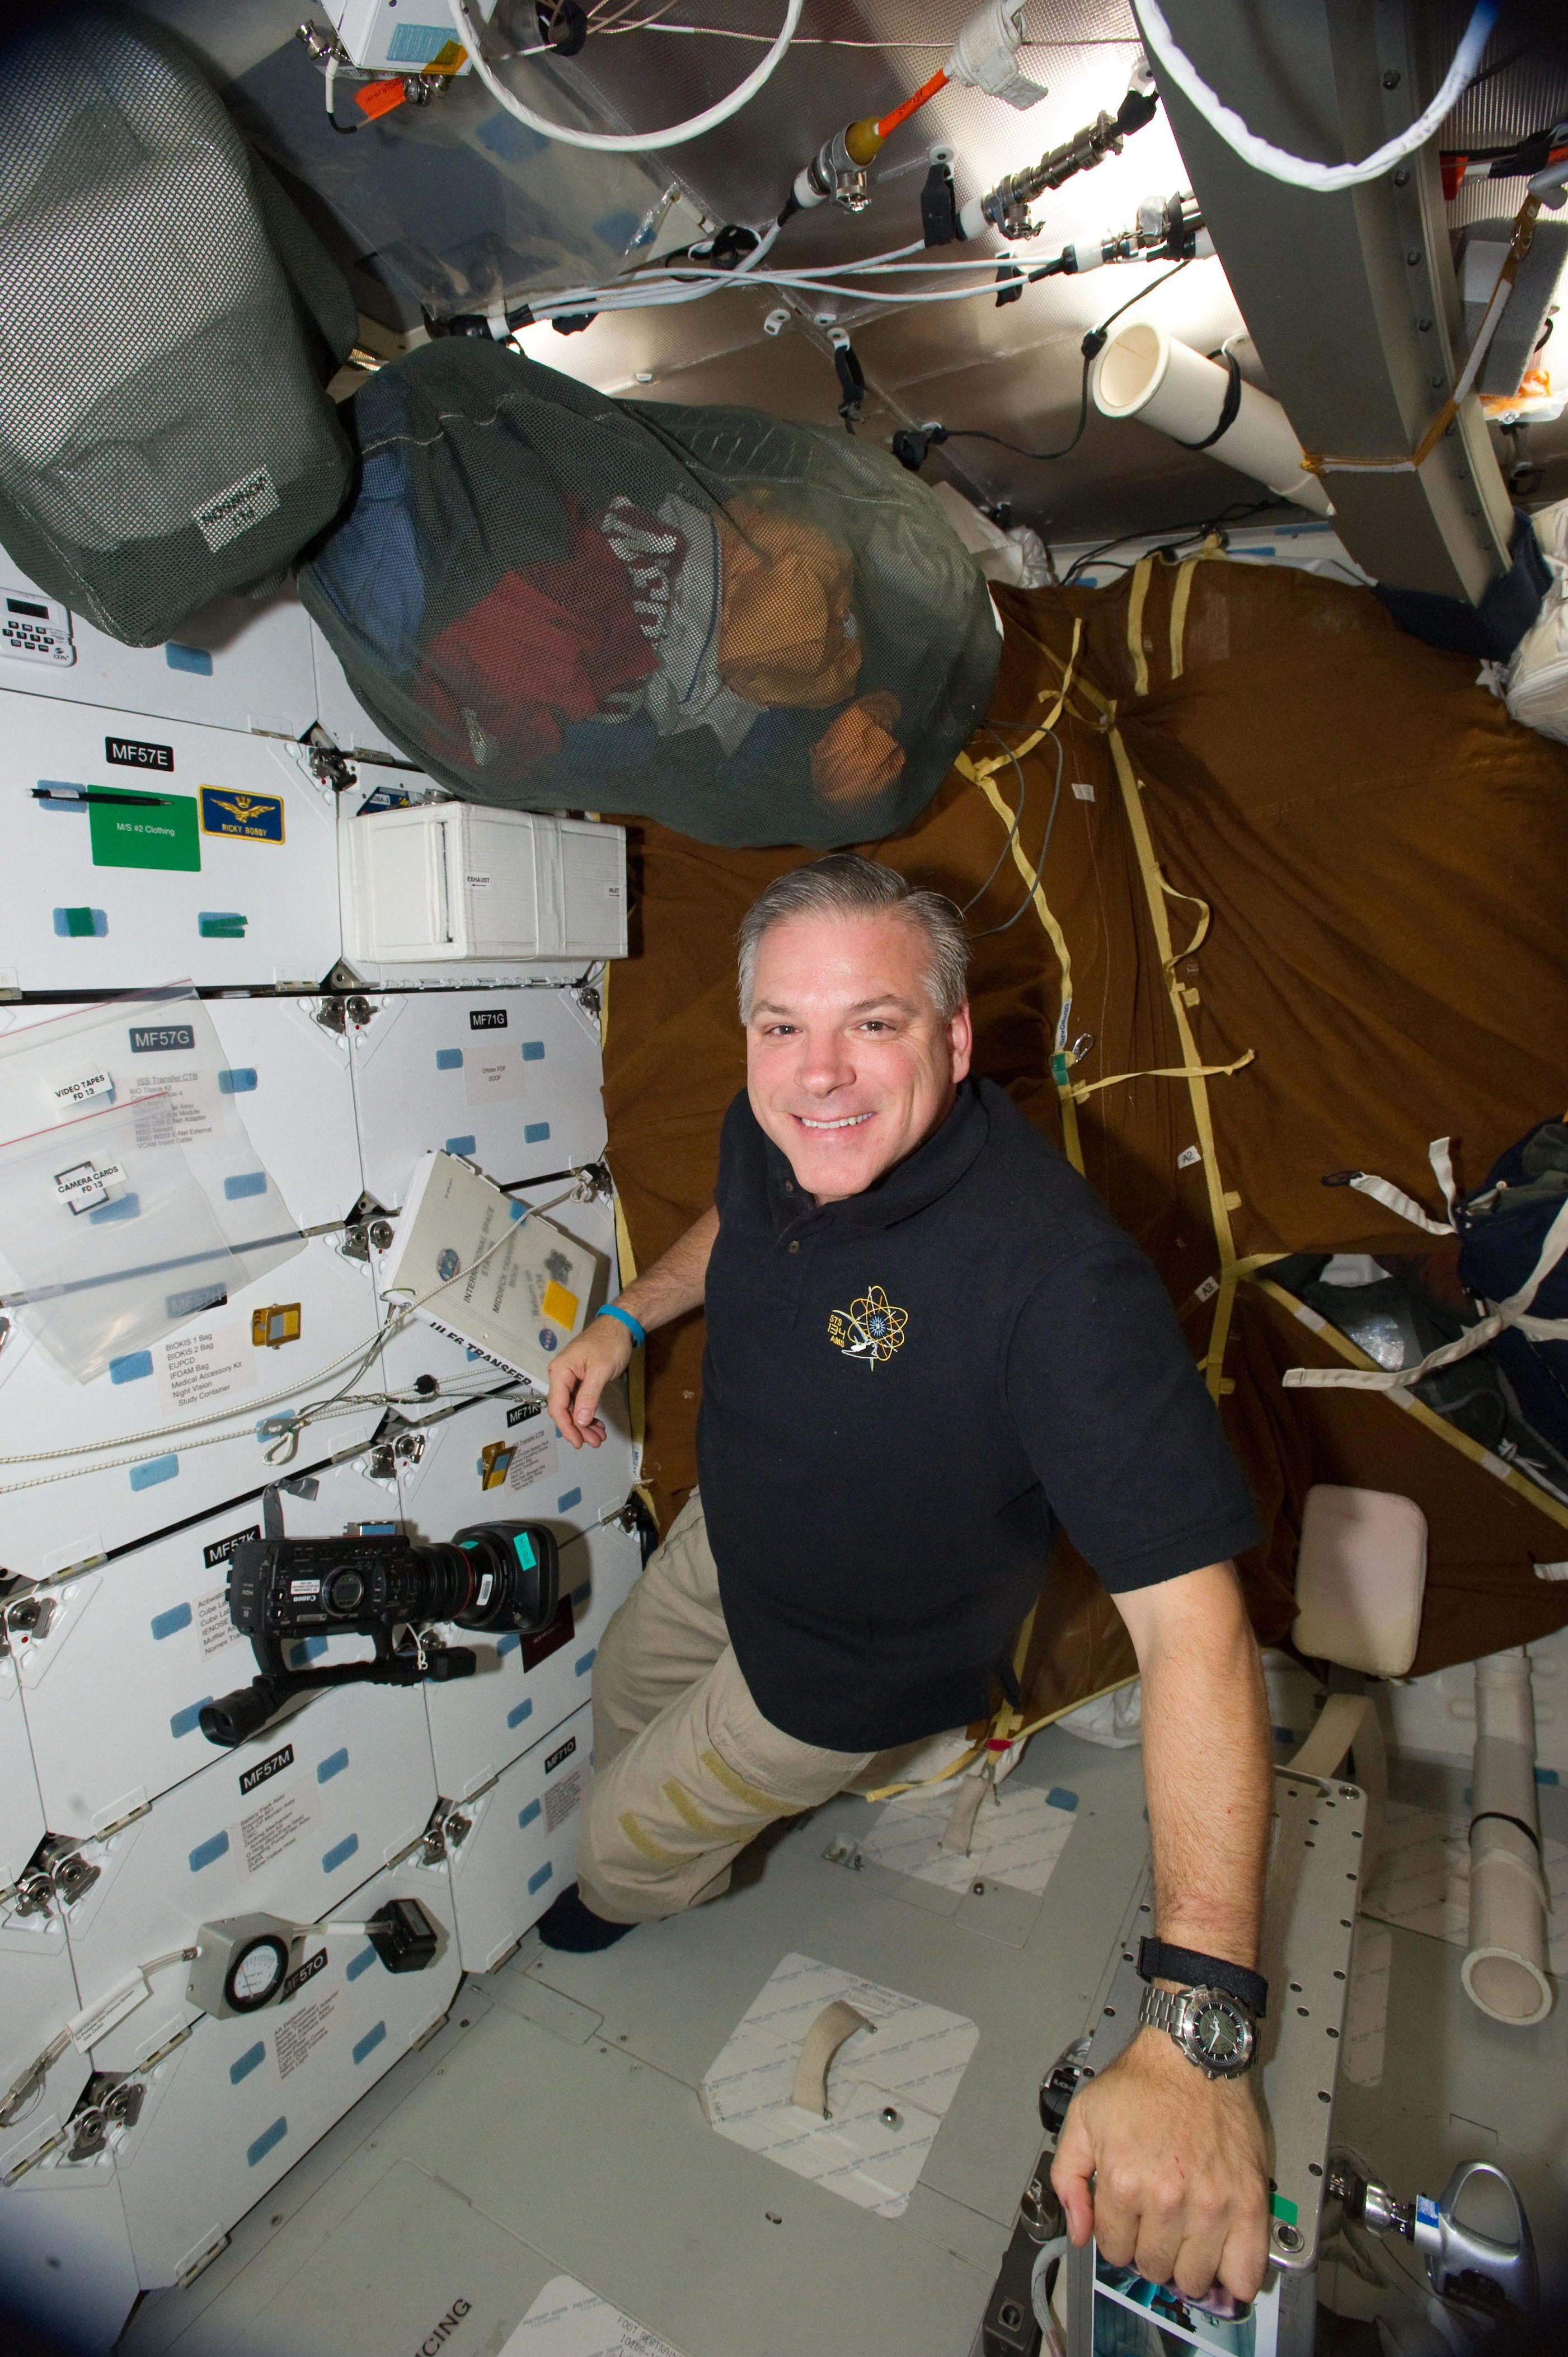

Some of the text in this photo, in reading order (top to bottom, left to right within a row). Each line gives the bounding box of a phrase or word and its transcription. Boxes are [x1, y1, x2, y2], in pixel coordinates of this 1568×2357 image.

[112, 743, 168, 765] MF57E
[116, 822, 132, 831] M/S
[145, 826, 175, 837] Clothing
[222, 823, 267, 836] RICKY BOBBY
[473, 1014, 505, 1025] MF71G
[135, 1030, 190, 1047] MF57G
[55, 1075, 105, 1098] VIDEO TAPES
[152, 1074, 181, 1084] Transfer
[1183, 1151, 1194, 1163] A2
[58, 1166, 118, 1193] CAMERA CARDS
[492, 1273, 506, 1313] MIDDECK
[1202, 1282, 1214, 1297] A3
[829, 1314, 842, 1327] STS
[166, 1339, 191, 1351] BIOKIS
[199, 1334, 212, 1342] Bag
[167, 1348, 193, 1361] BIOKIS
[200, 1343, 214, 1351] Bag
[169, 1357, 195, 1370] EUPCD
[196, 1363, 209, 1371] Bag
[171, 1376, 198, 1389] Medical
[199, 1365, 232, 1380] Accessory
[173, 1381, 213, 1398] Night Vision
[178, 1385, 231, 1407] Study Container
[199, 1605, 217, 1618] Cube
[200, 1614, 218, 1627] Cube
[205, 1640, 228, 1655] Nomex
[244, 1750, 290, 1789] MF57M
[617, 2316, 638, 2333] FOOT
